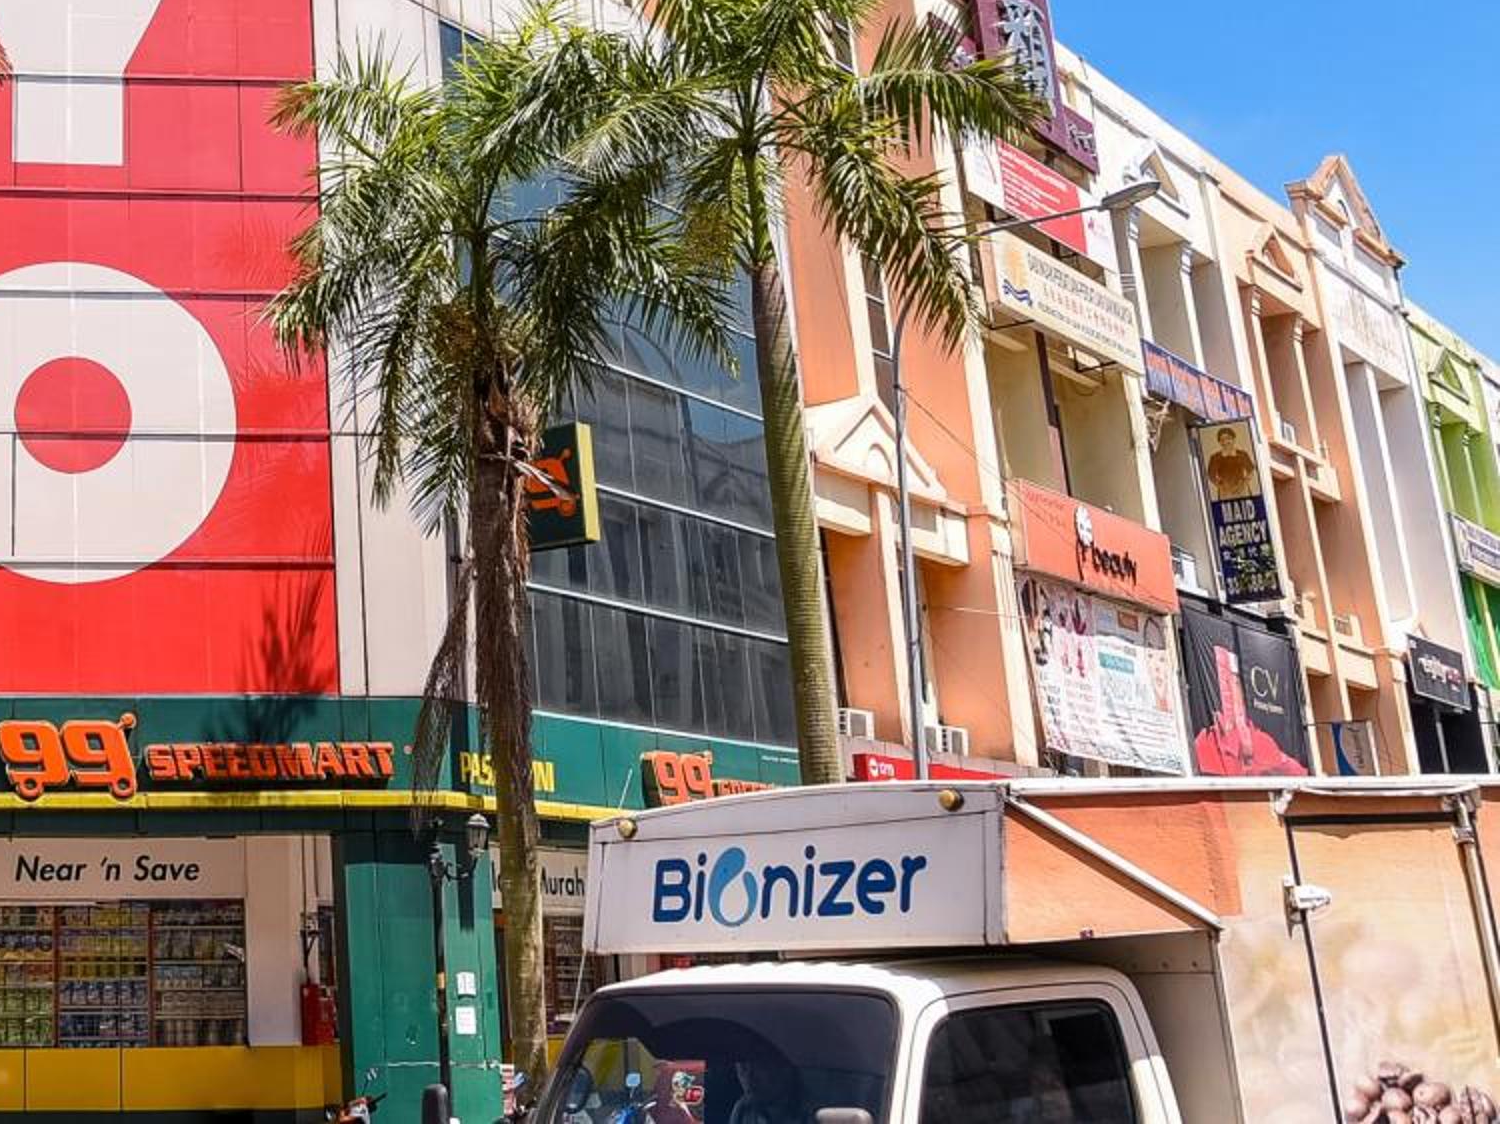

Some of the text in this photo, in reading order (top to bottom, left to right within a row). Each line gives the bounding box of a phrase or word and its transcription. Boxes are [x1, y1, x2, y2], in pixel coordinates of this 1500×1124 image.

[1221, 499, 1257, 524] MAID
[1219, 521, 1267, 548] AGENCY
[146, 741, 395, 780] SPEEDMART
[459, 751, 497, 787] PAS
[642, 749, 714, 806] 99
[15, 855, 87, 882] Near
[133, 854, 200, 882] Save
[652, 844, 928, 928] Bionizer
